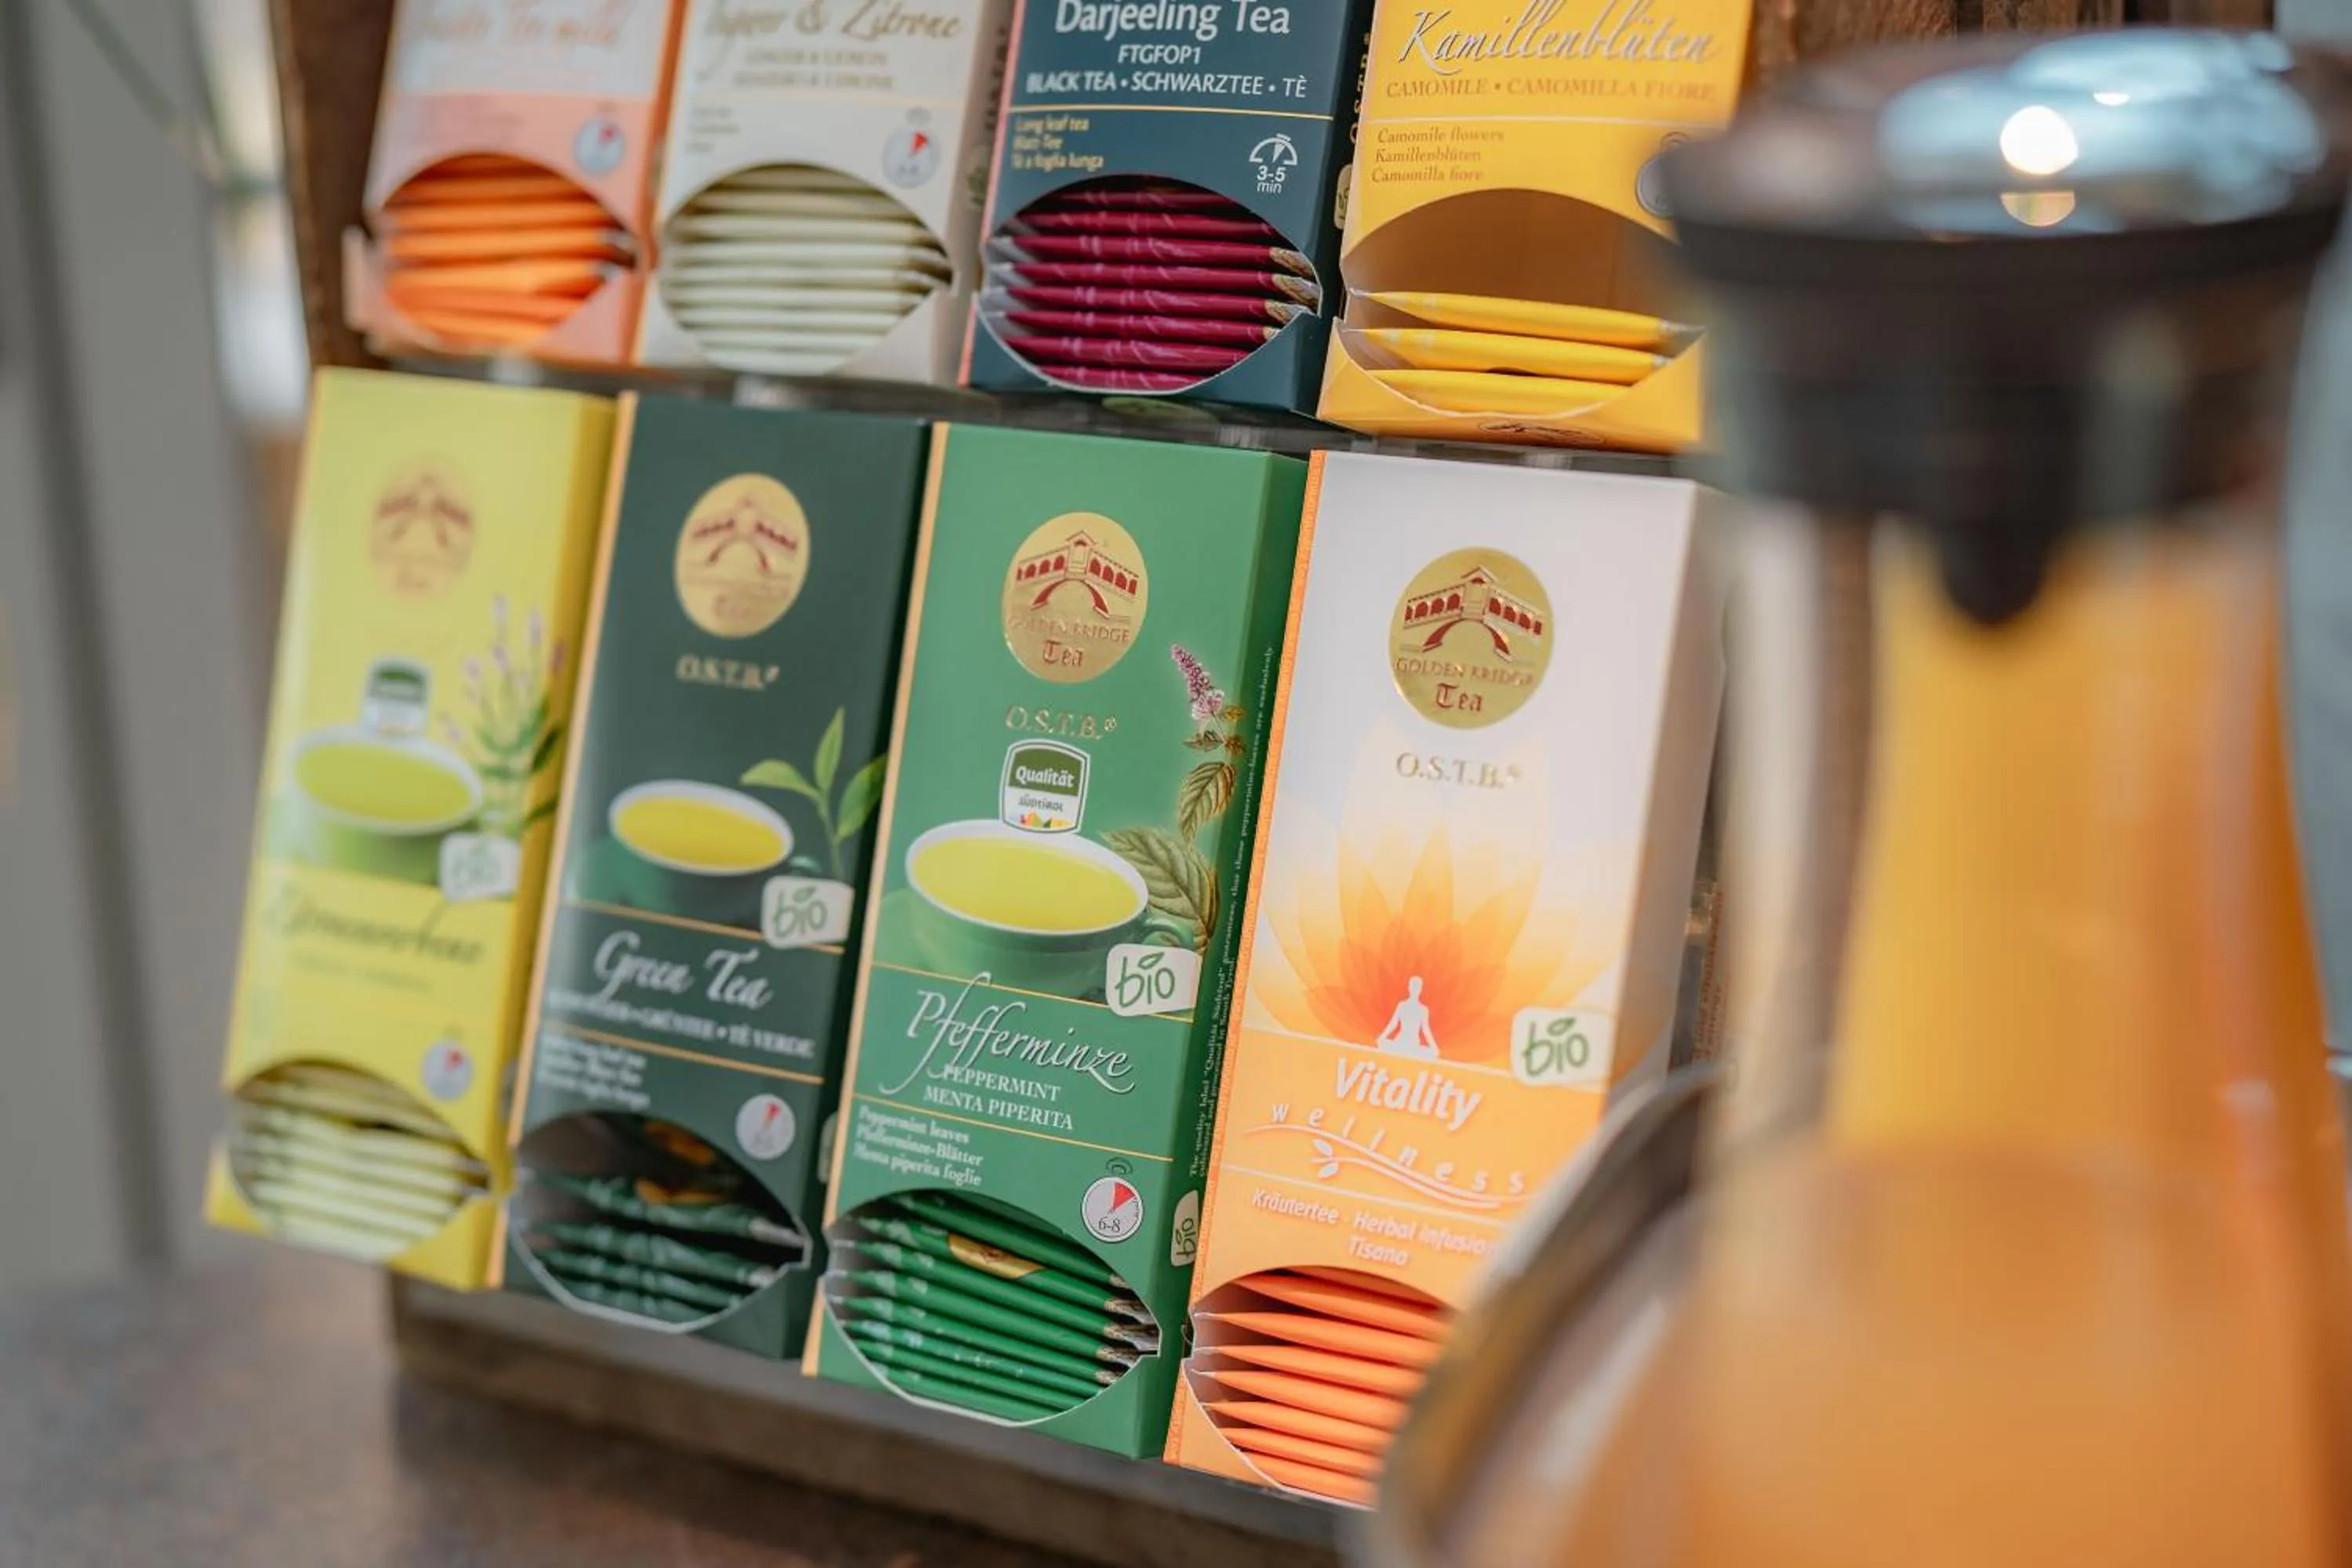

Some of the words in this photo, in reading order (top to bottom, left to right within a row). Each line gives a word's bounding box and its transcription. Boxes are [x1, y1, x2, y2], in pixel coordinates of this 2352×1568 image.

[1055, 0, 1221, 42] Darjeeling
[1232, 0, 1290, 34] Tea
[1398, 0, 1722, 76] Kamillenblüten
[1118, 44, 1201, 64] FTGFOP1
[1025, 72, 1080, 94] BLACK
[1083, 72, 1116, 92] TEA
[1131, 71, 1263, 96] SCHWARZTEE
[1283, 75, 1307, 98] TÈ
[1386, 79, 1489, 98] CAMOMILE
[1506, 77, 1638, 96] CAMOMILLA
[1377, 128, 1446, 143] Camomile
[1450, 127, 1504, 142] flowers
[1374, 147, 1482, 162] Kamillenblüten
[1256, 166, 1287, 182] 3-5
[1256, 180, 1283, 194] min
[1371, 167, 1446, 183] Camomilla
[1449, 168, 1484, 182] fiore
[1043, 639, 1083, 668] Tea
[1396, 657, 1465, 678] GOLDEN
[1436, 682, 1483, 712] Tea
[1015, 765, 1076, 787] Qualität
[771, 886, 829, 939] bio
[593, 930, 696, 1000] Green
[705, 949, 775, 1010] Tea
[1114, 951, 1176, 1008] bio
[878, 971, 1136, 1095] Pfefferminze
[1523, 1018, 1589, 1076] bio
[943, 1064, 1062, 1102] PEPPERMINT
[1334, 1058, 1481, 1131] Vitality
[923, 1085, 983, 1112] MENTA
[987, 1098, 1074, 1131] PIPERITA
[930, 1119, 970, 1145] leaves
[1271, 1104, 1525, 1195] wellness
[942, 1163, 982, 1188] foglie
[1098, 1216, 1121, 1233] 6-8
[1252, 1189, 1341, 1225] Kräutertee
[1353, 1212, 1417, 1240] Herbal
[1175, 1218, 1196, 1258] bio
[1349, 1235, 1409, 1266] Tisana
